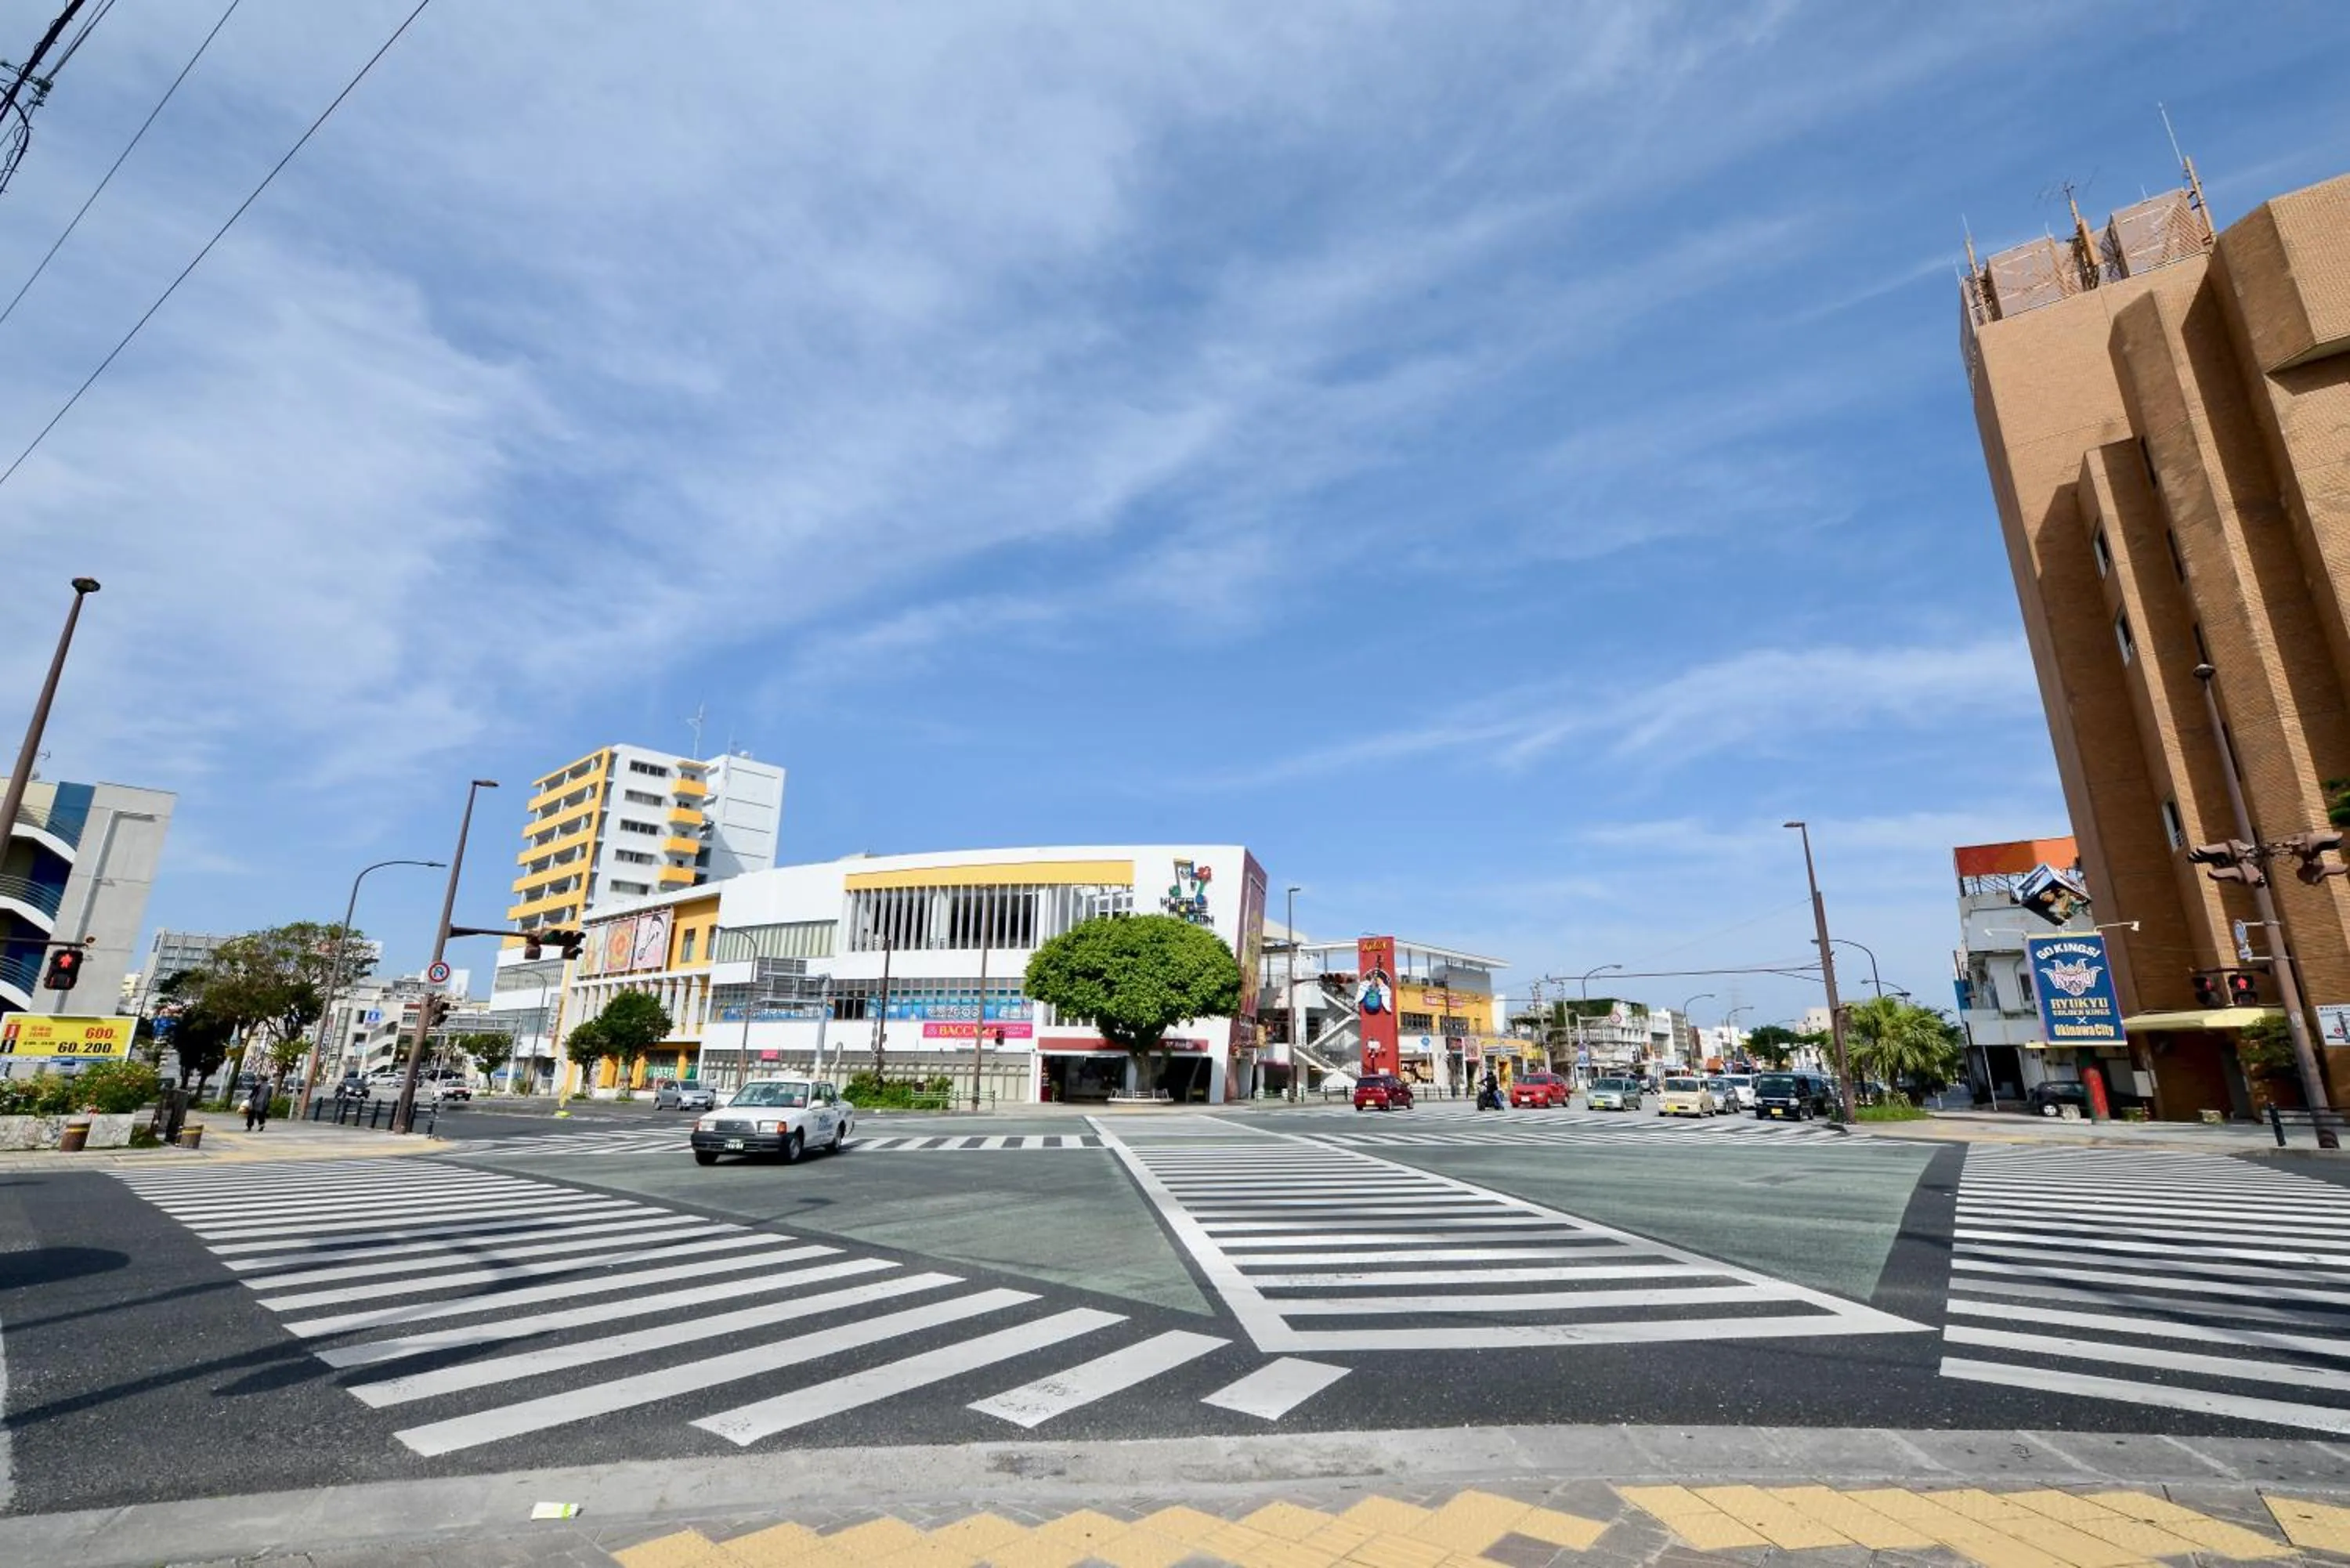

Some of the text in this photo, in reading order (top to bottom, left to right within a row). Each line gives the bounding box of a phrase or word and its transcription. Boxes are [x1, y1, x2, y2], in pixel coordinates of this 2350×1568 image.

[2050, 998, 2108, 1010] RYUKYU
[85, 1027, 114, 1039] 600
[57, 1042, 78, 1053] 60
[83, 1042, 113, 1053] 200
